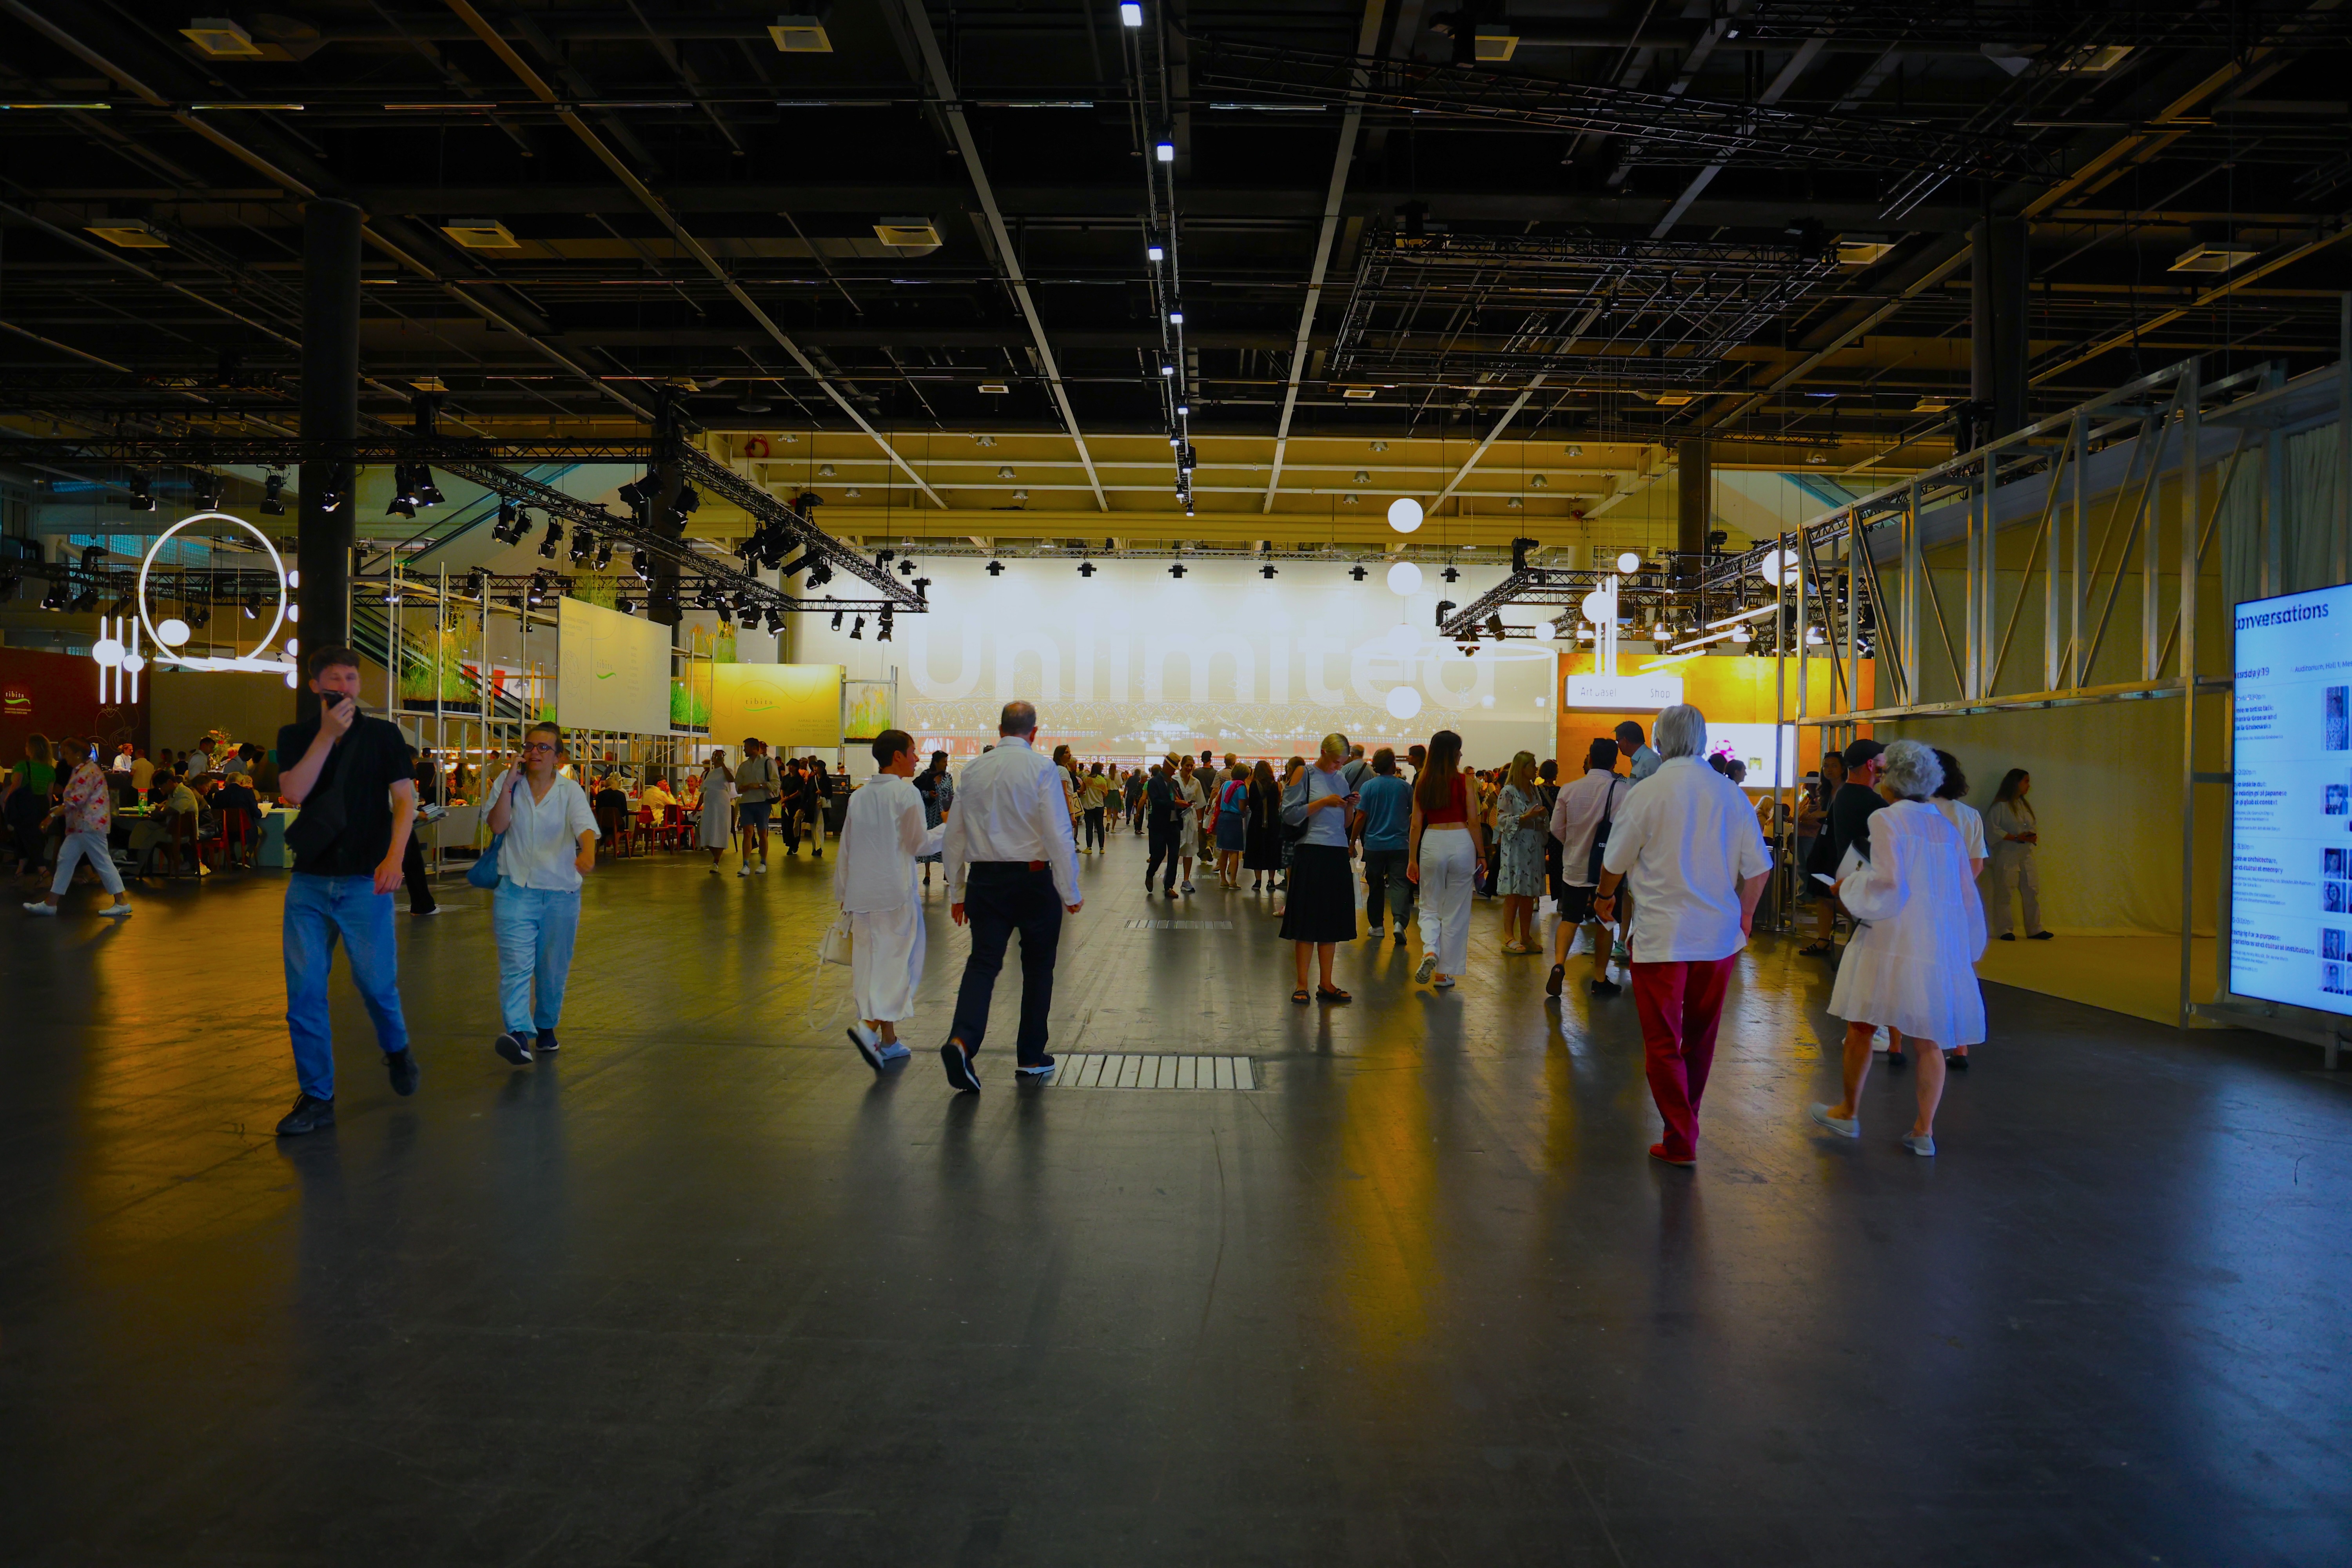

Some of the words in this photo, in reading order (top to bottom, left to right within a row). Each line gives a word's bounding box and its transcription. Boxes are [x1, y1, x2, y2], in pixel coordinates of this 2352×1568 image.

[907, 603, 1495, 710] Unlimited
[597, 659, 612, 670] tibits
[1581, 687, 1592, 696] Art
[1650, 688, 1670, 699] Shop
